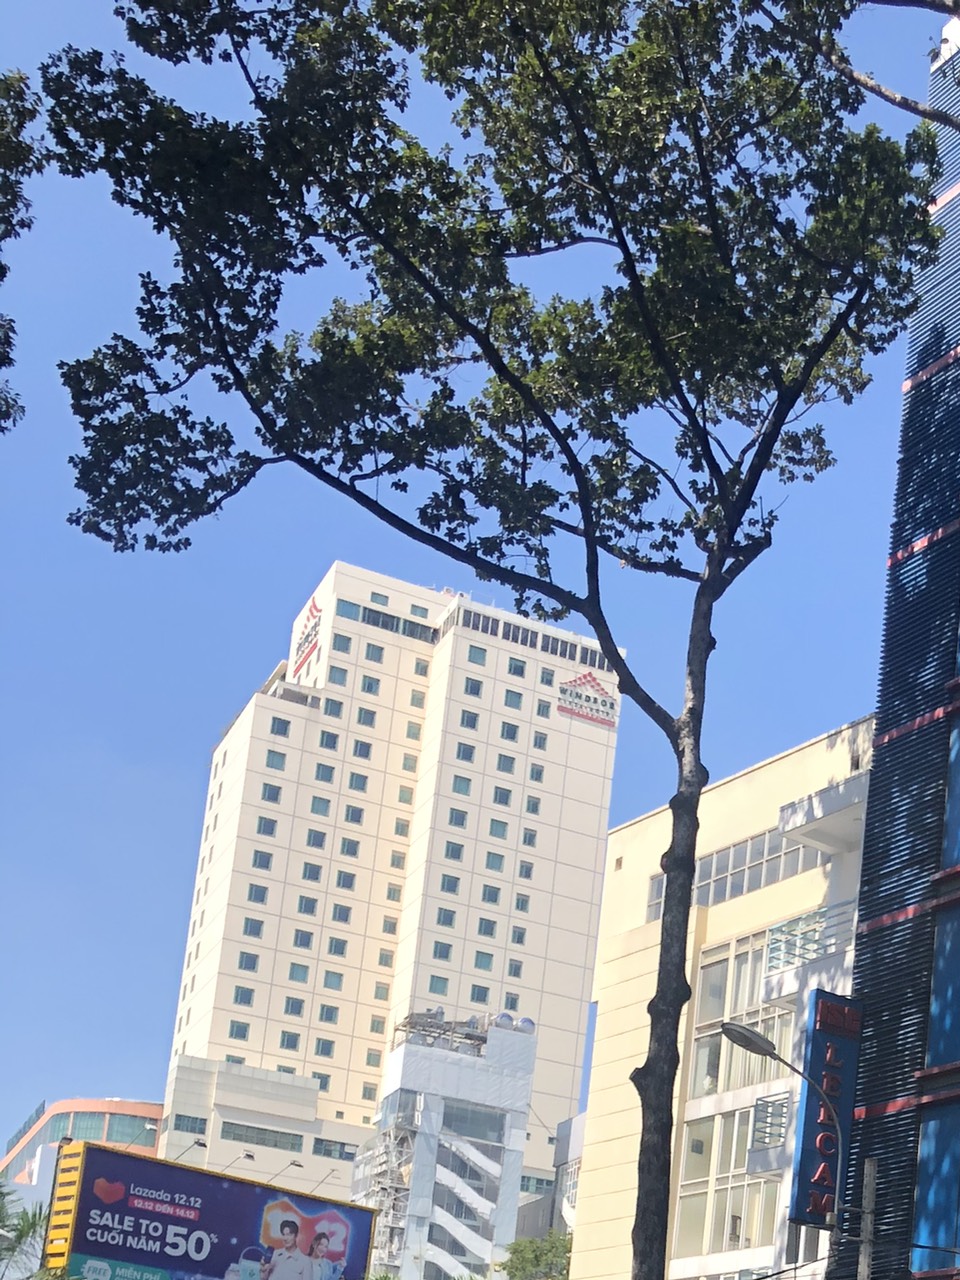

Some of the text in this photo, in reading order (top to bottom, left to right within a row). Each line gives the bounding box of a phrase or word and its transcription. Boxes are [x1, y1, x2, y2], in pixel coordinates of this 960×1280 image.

[806, 1042, 843, 1216] LEECAM
[130, 1183, 202, 1208] Lazada 12.12
[88, 1209, 163, 1237] SALE TO
[86, 1228, 160, 1254] CUỐI NĂM
[115, 1266, 142, 1280] MIỄN
